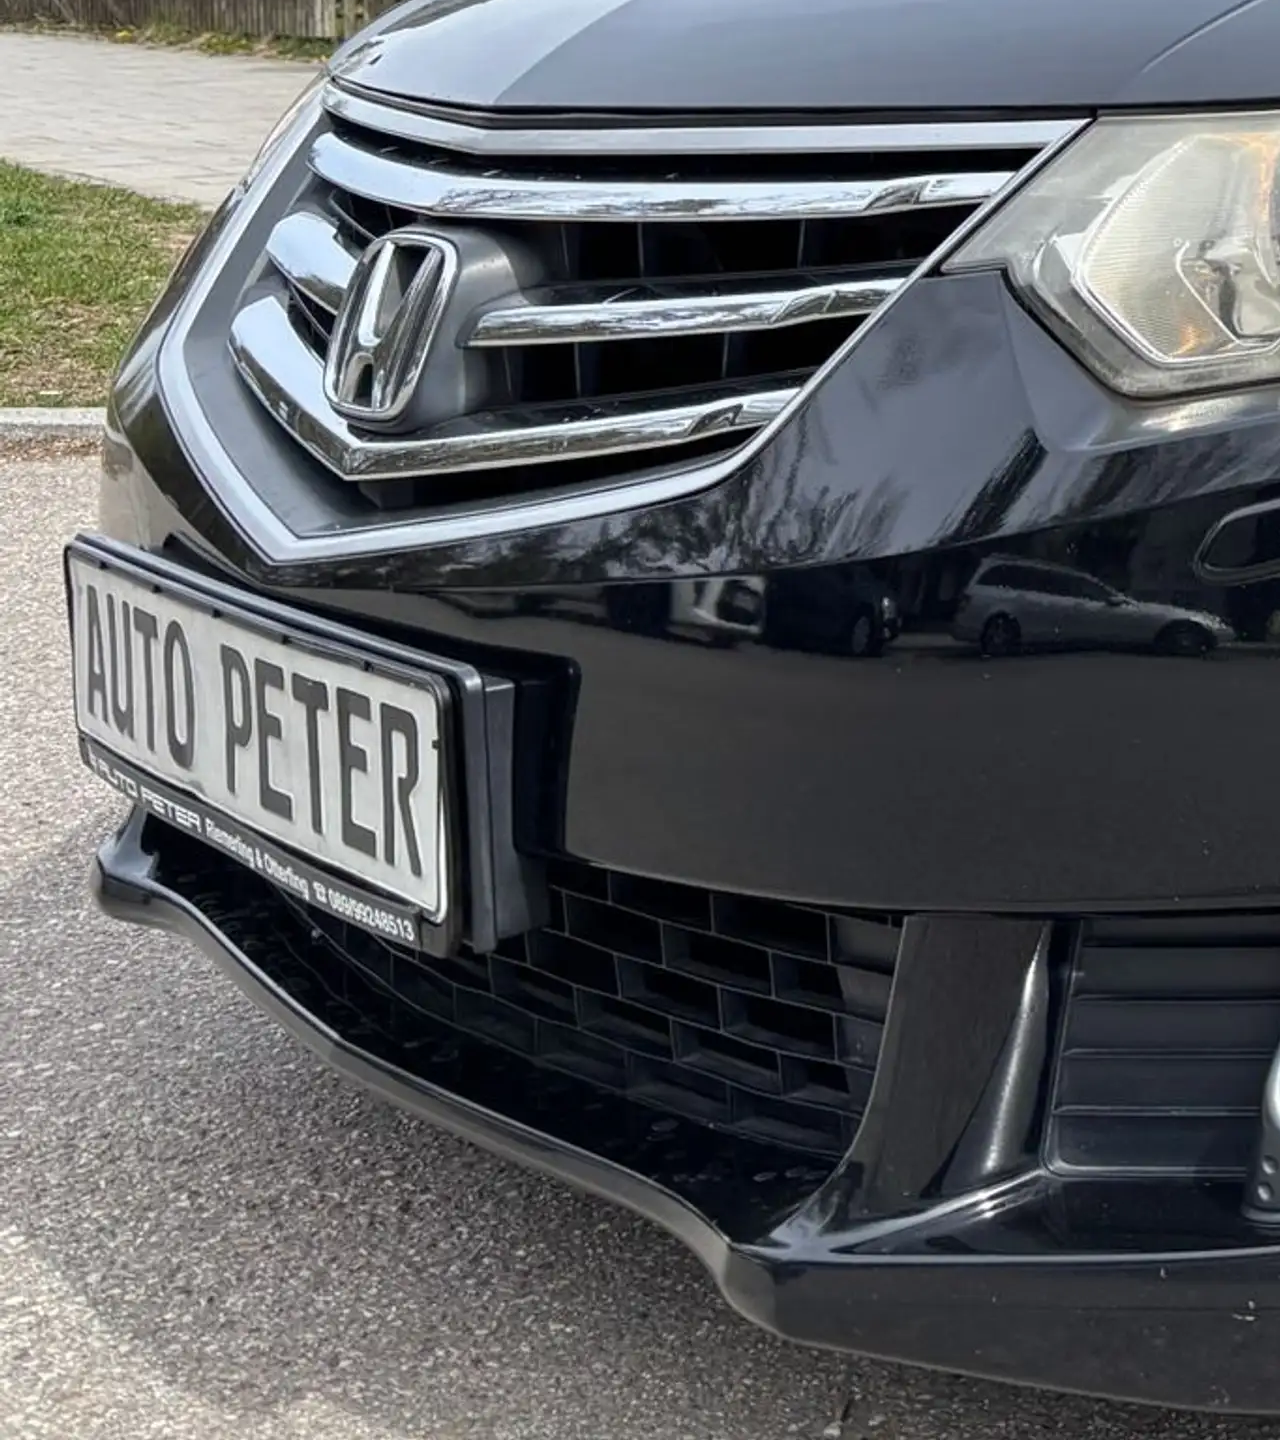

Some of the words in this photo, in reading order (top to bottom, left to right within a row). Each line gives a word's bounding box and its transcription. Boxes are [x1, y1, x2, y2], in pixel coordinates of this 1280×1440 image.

[87, 584, 198, 769] AUTO
[219, 644, 422, 878] PETER
[141, 786, 202, 833] PETER
